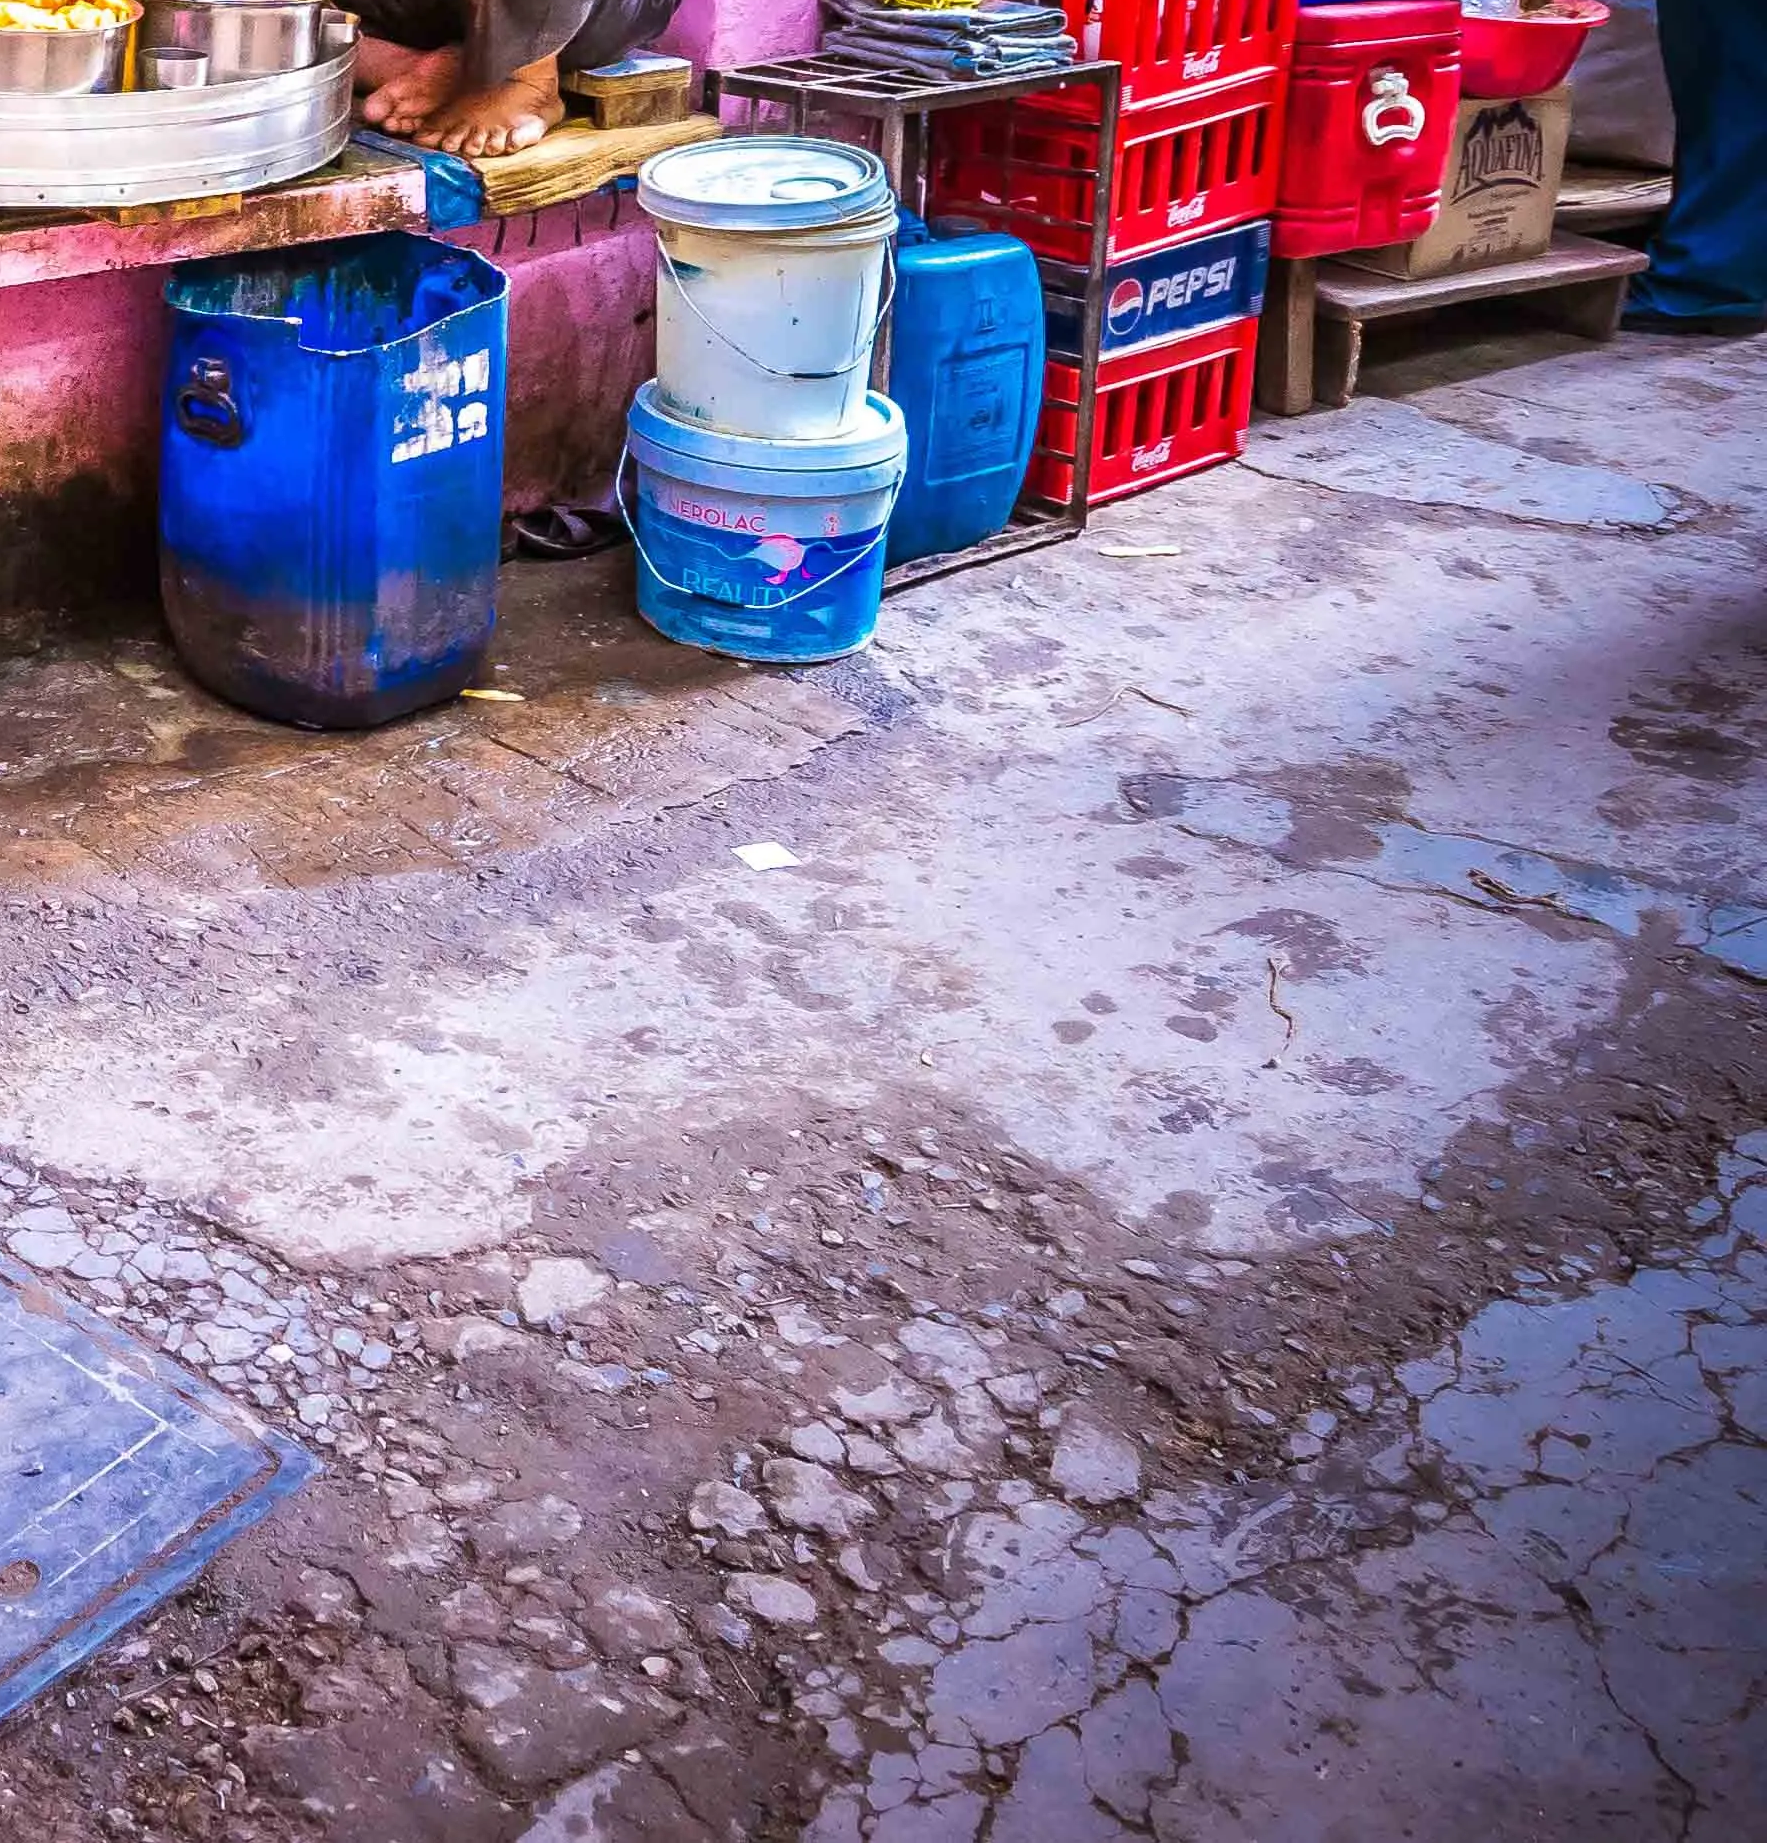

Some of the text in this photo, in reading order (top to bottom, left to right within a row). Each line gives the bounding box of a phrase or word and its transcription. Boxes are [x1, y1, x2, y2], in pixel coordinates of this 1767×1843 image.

[1451, 130, 1545, 199] AQUAFINA
[1146, 256, 1237, 316] PEPSI
[668, 497, 766, 533] NEROLAC
